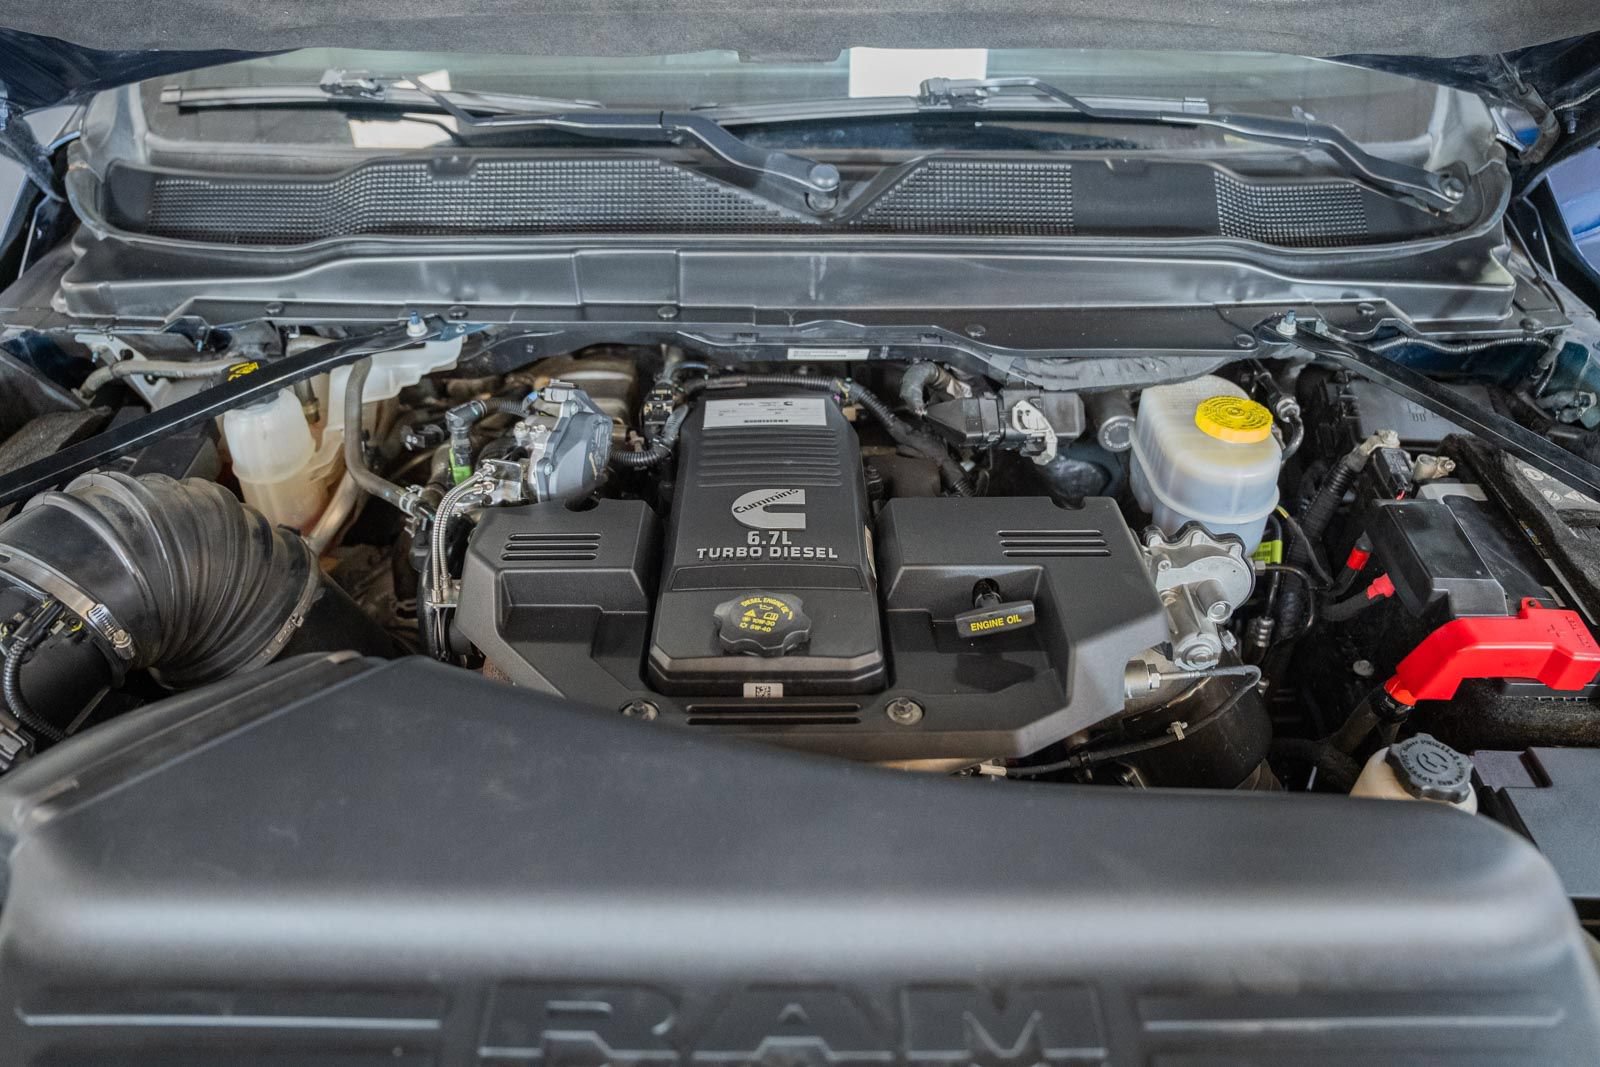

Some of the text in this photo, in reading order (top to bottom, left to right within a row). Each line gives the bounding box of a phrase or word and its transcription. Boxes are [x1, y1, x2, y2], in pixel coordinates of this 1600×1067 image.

[733, 488, 799, 514] Cummins
[747, 531, 792, 546] 6.7L
[697, 546, 838, 559] TURBO DIESEL
[970, 614, 1022, 632] ENGINE OIL
[478, 978, 1109, 1061] RAM
